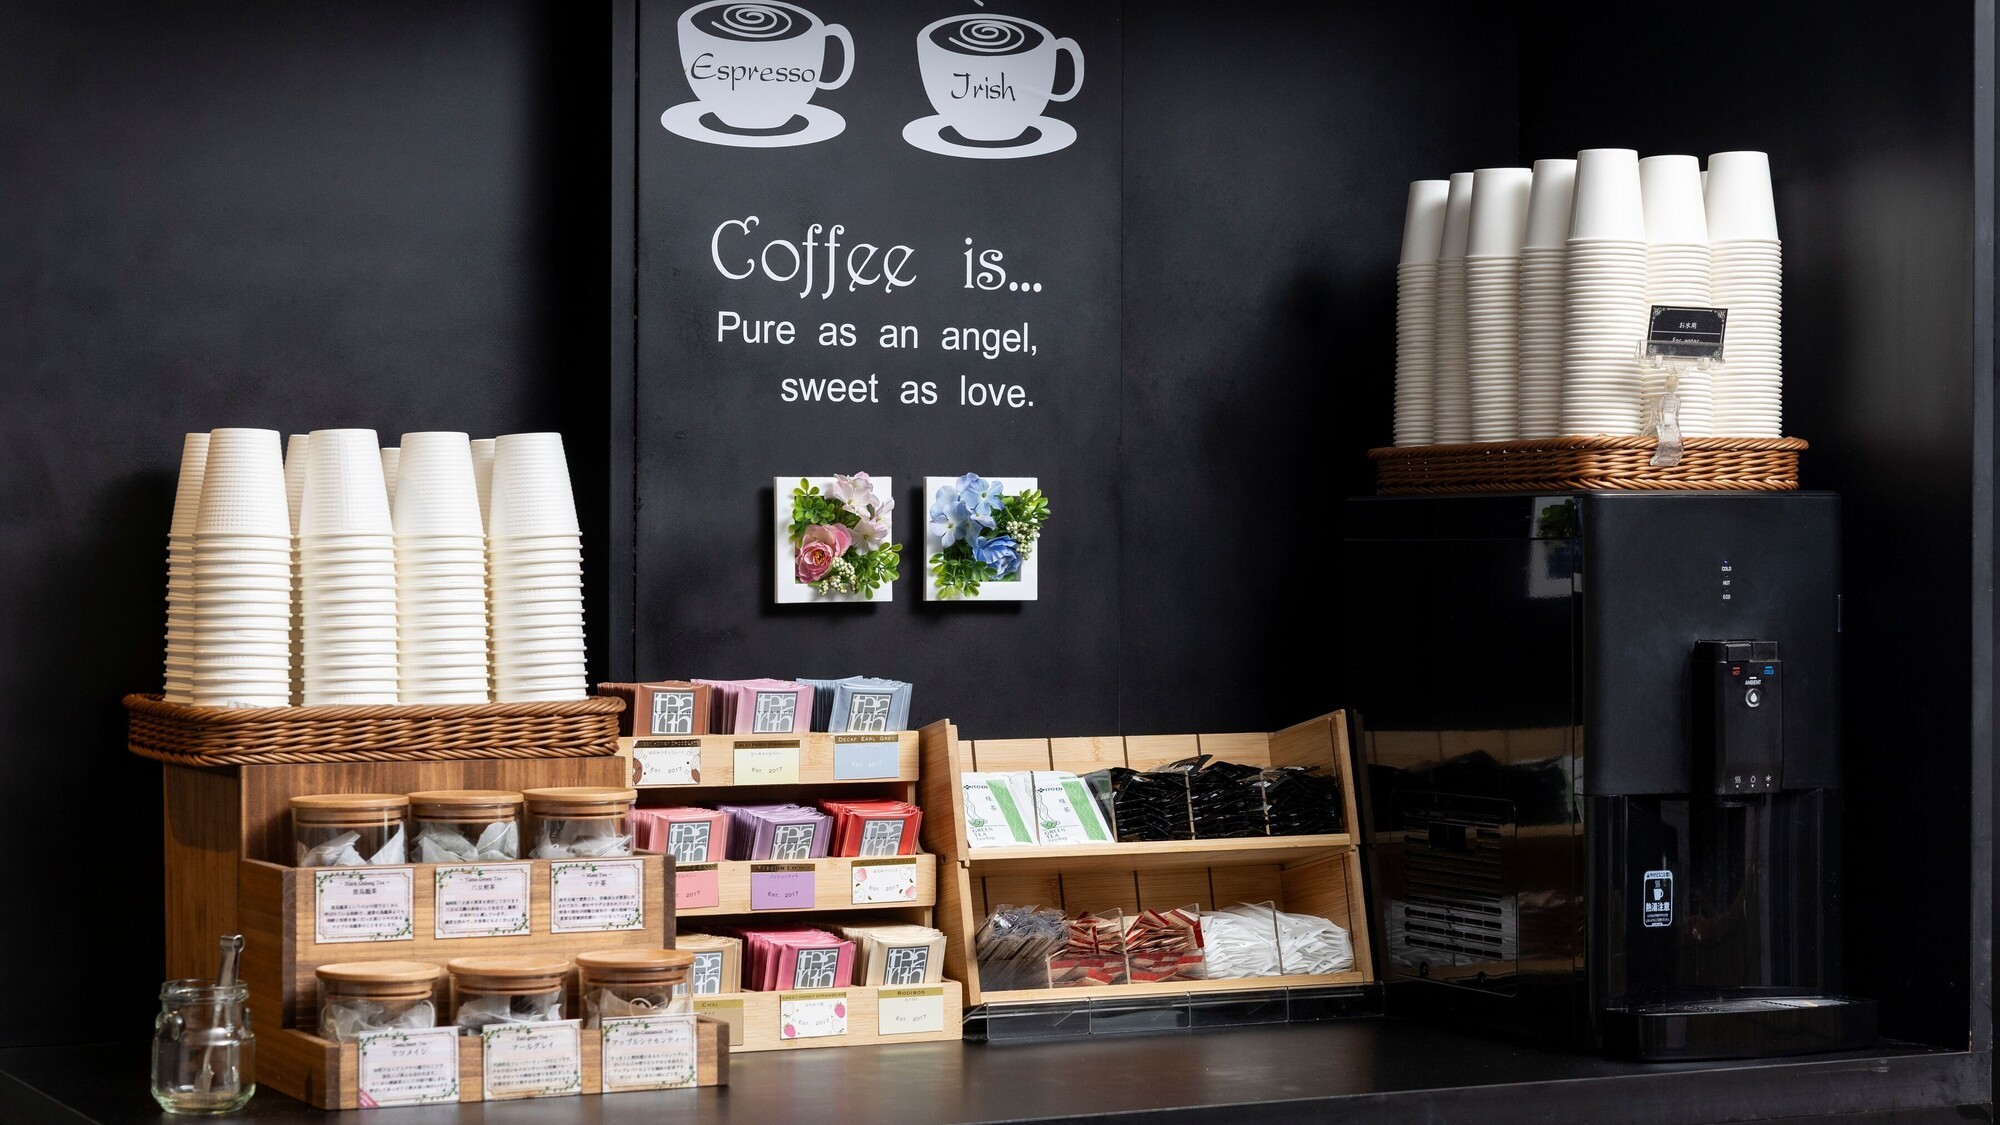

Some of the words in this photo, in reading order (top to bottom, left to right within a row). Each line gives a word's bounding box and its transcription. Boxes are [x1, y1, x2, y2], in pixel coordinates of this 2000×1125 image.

[690, 53, 815, 90] Espresso
[951, 72, 1015, 101] Irish
[712, 216, 916, 299] Coffee
[964, 238, 1042, 292] is...
[718, 311, 795, 344] Pure
[819, 323, 856, 346] as
[880, 325, 918, 348] an
[942, 323, 1036, 359] angel,
[781, 374, 878, 403] sweet
[901, 381, 937, 404] as
[961, 375, 1033, 407] love.
